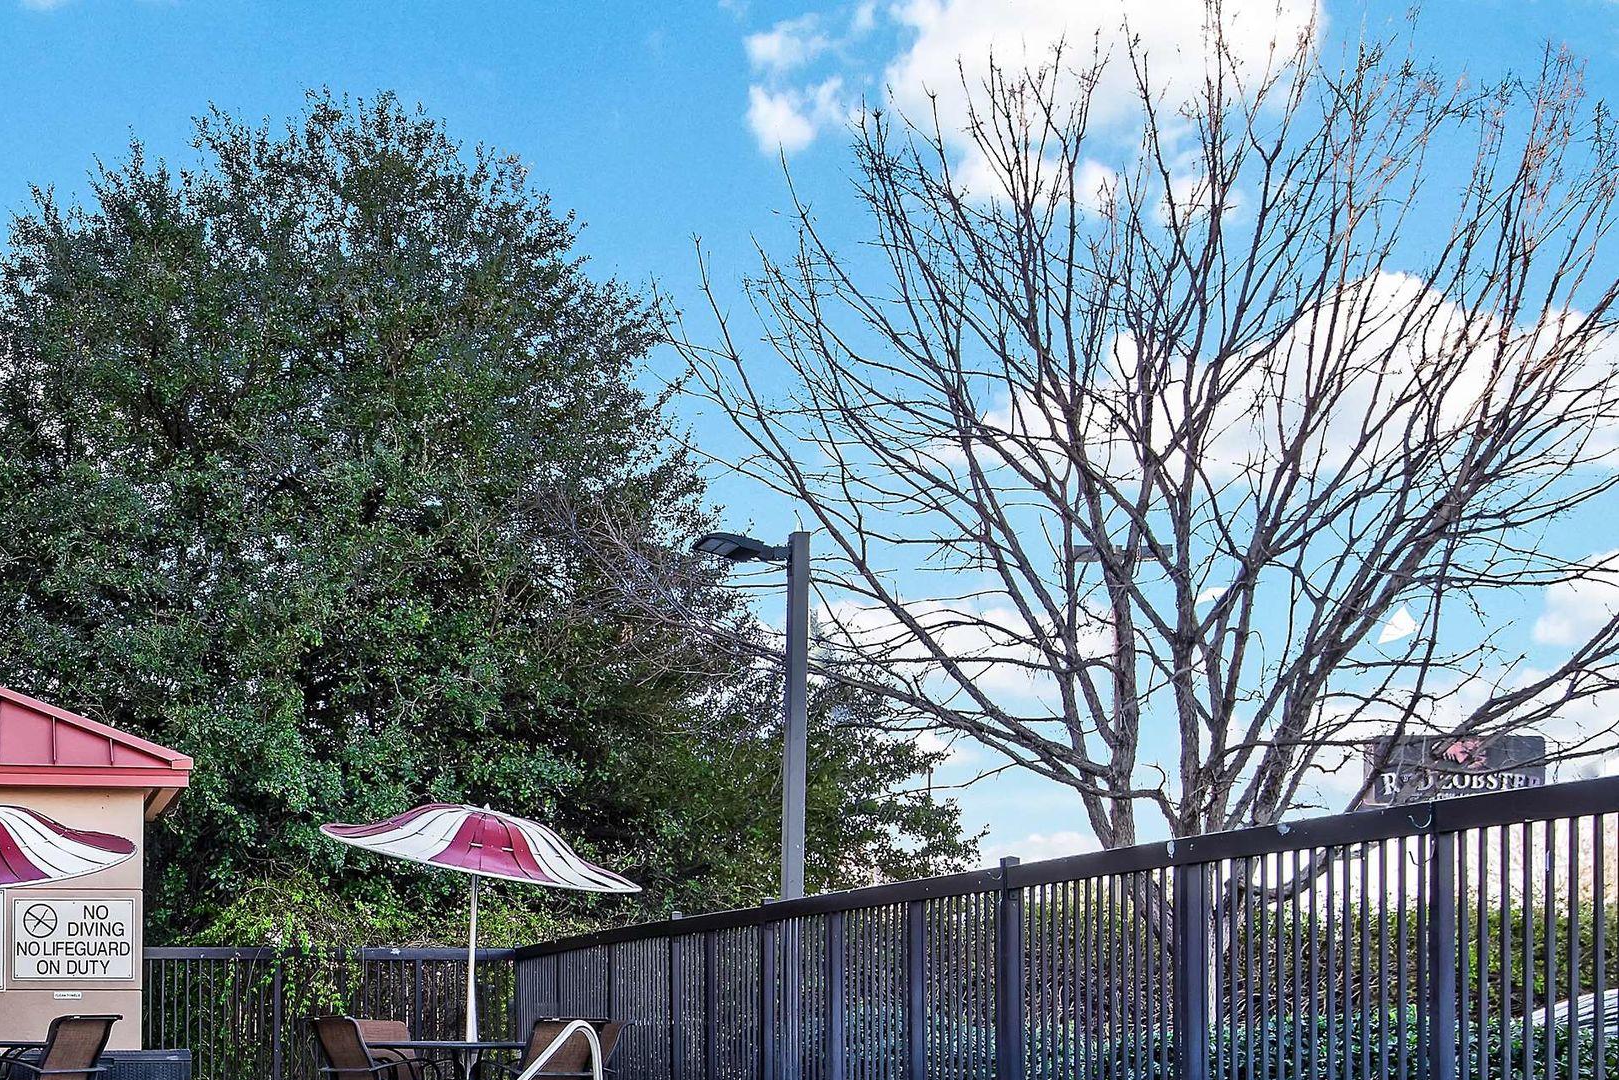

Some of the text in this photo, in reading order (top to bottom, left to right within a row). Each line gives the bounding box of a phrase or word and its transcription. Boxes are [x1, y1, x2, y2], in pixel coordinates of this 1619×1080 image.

[83, 904, 109, 920] NO
[67, 921, 125, 937] DIVING
[16, 941, 131, 957] NO LIFEGUARD
[36, 959, 110, 975] ON DUTY
